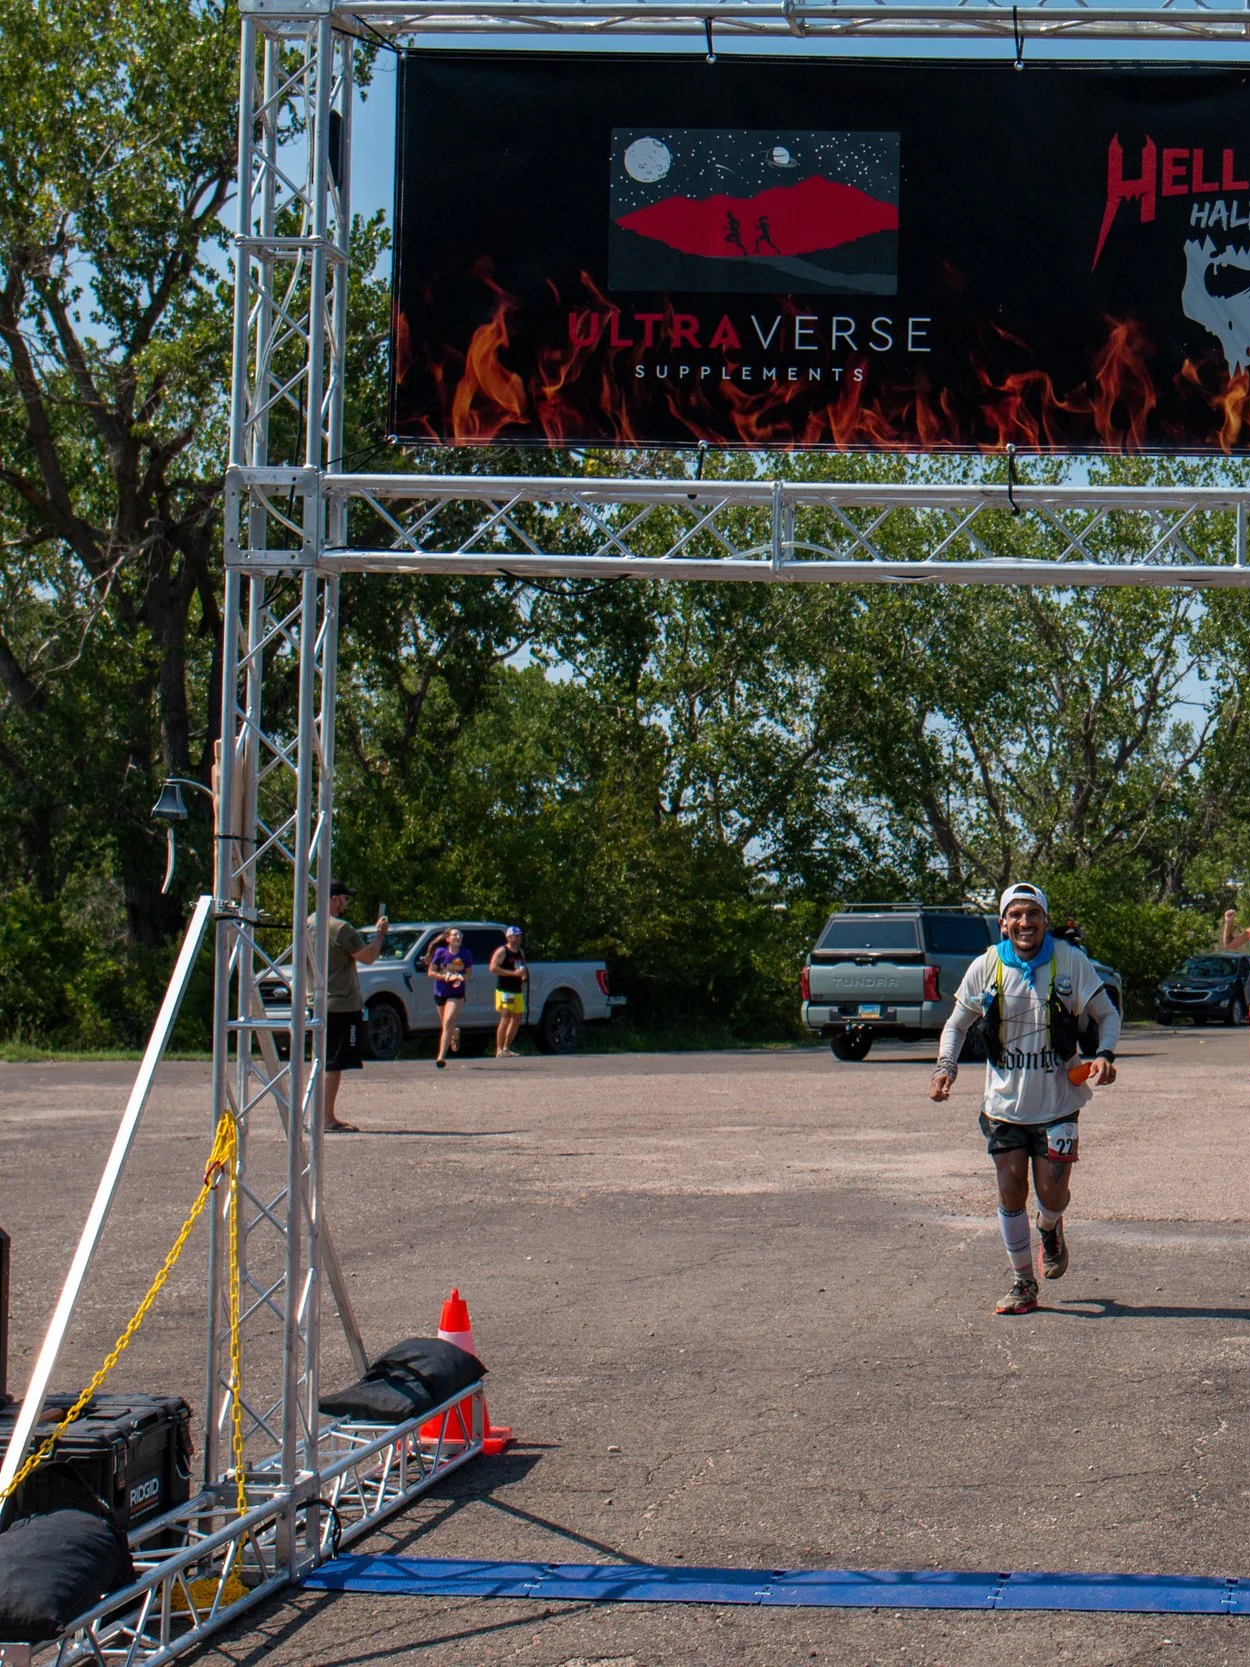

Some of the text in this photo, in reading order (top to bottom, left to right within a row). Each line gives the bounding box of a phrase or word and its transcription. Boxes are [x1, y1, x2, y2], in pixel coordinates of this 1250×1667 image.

[1091, 131, 1250, 274] HELL
[567, 312, 932, 352] ULTRAVERSE
[634, 364, 864, 382] SUPPLEMENTS
[832, 977, 898, 988] TUNDRA
[130, 1477, 159, 1508] RIDGID
